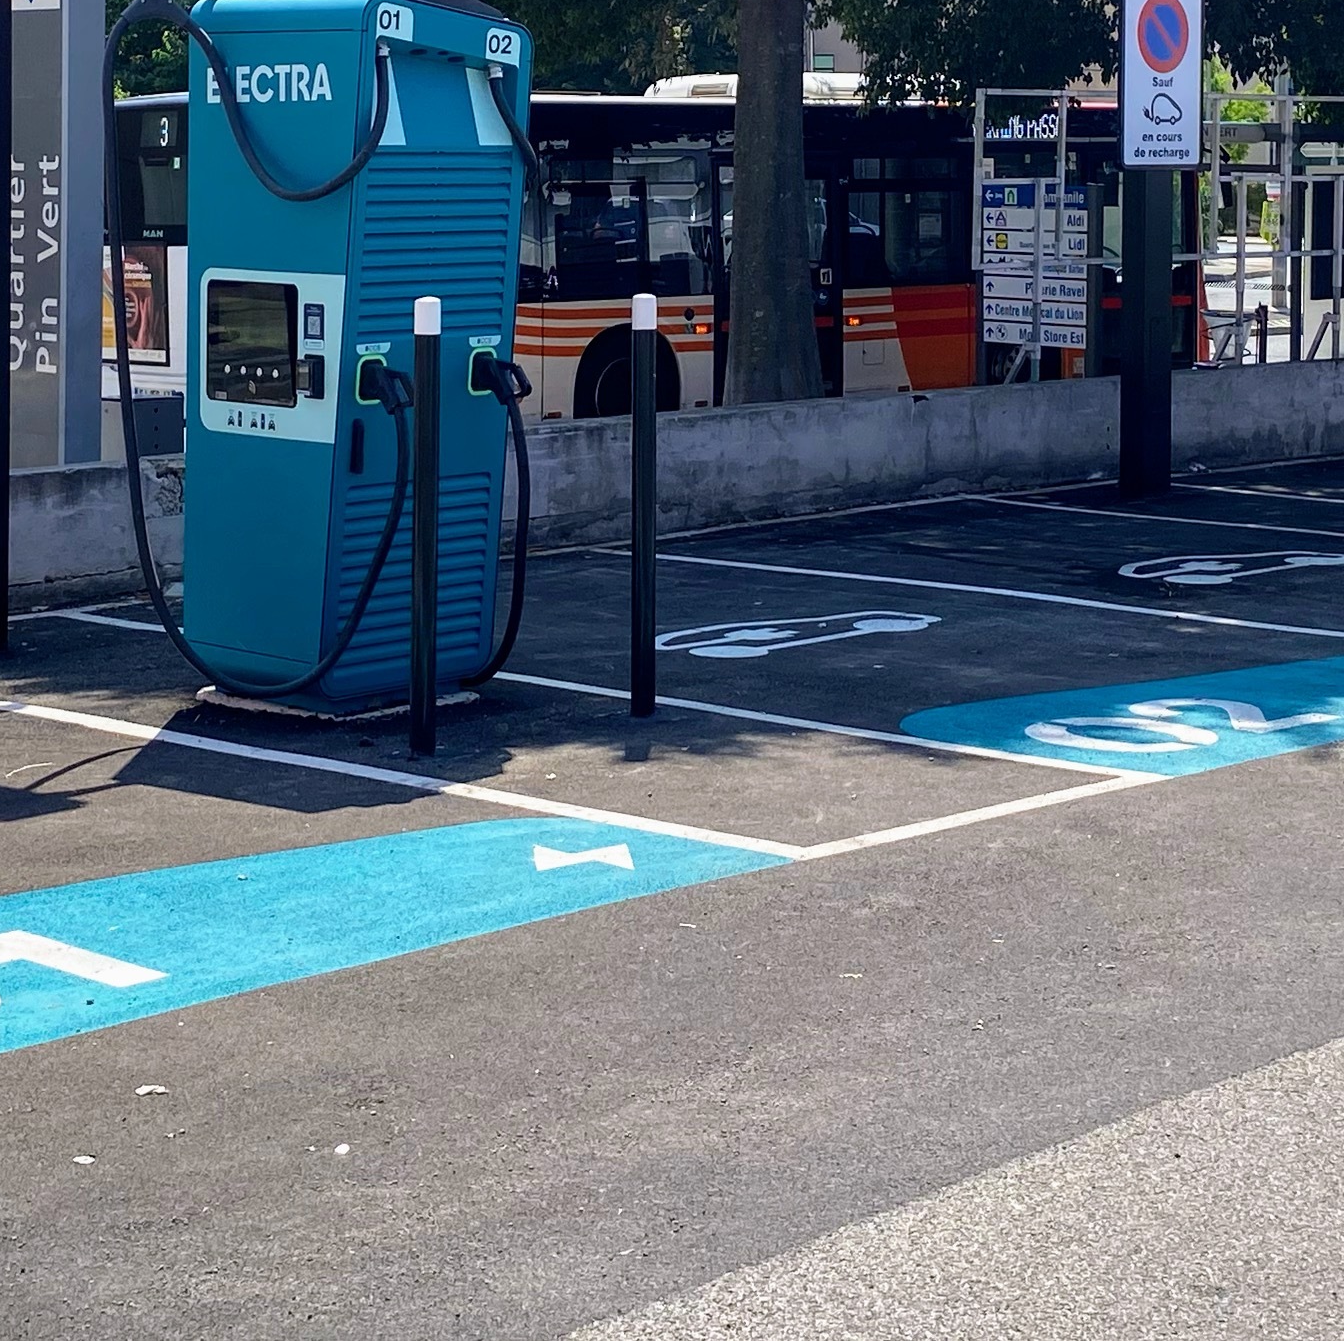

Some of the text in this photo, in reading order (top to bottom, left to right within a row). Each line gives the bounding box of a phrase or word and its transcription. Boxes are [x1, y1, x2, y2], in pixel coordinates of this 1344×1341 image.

[379, 9, 400, 30] 01
[488, 34, 512, 54] 02
[207, 63, 332, 103] EECTRA
[1152, 77, 1174, 87] Sauf
[160, 117, 169, 147] 3
[1142, 133, 1183, 142] en cours
[1134, 147, 1190, 159] de recharge
[1067, 214, 1085, 226] Aldi
[142, 230, 164, 238] MAN
[1068, 238, 1086, 250] Lidl
[35, 154, 60, 374] Pin Vert
[1059, 284, 1085, 297] Ravel
[995, 303, 1020, 317] Centre
[1067, 308, 1084, 320] Lion
[1043, 330, 1068, 343] Store
[1070, 331, 1084, 344] Est
[1024, 698, 1342, 753] 02
